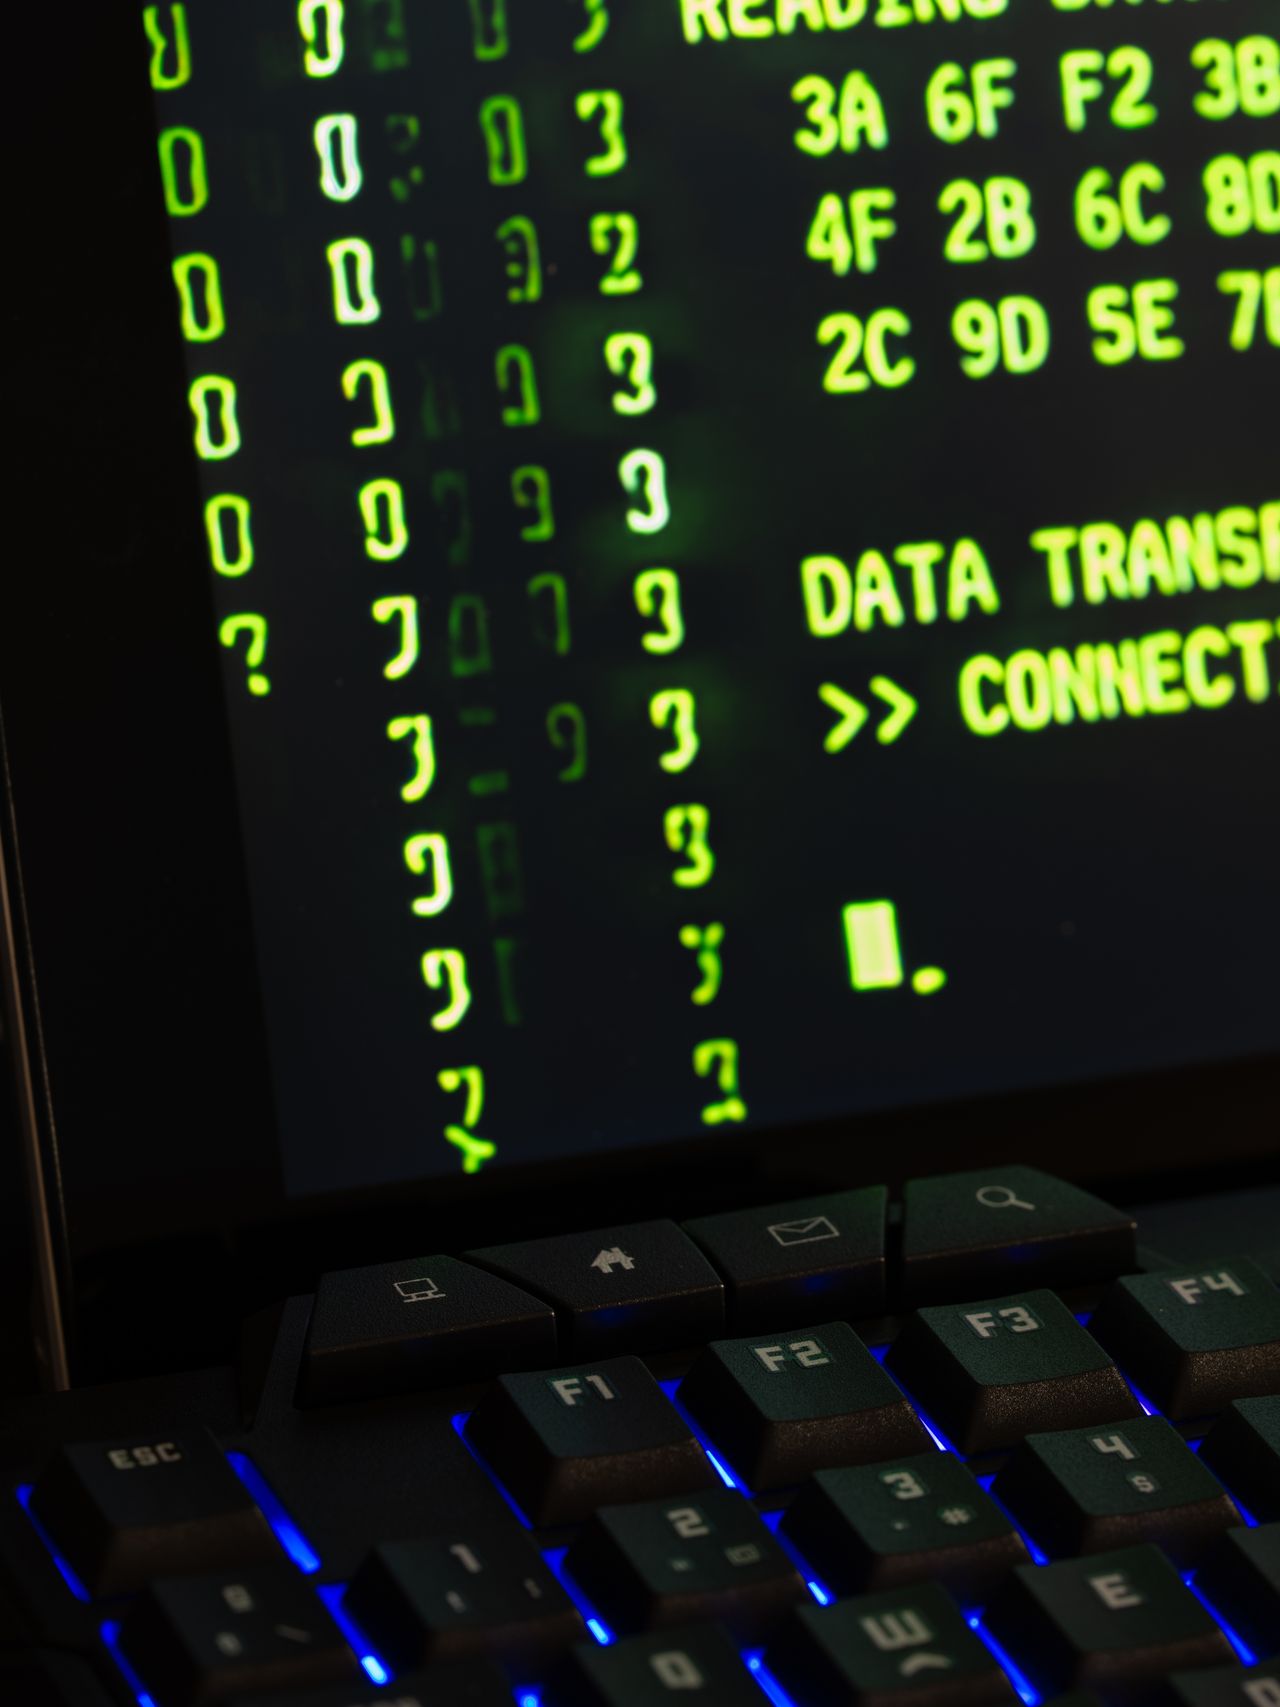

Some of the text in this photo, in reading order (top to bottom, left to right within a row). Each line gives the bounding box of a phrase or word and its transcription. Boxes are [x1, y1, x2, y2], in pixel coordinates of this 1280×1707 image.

[791, 70, 888, 157] 3A
[925, 57, 1016, 144] 6F
[1059, 45, 1157, 132] F2
[806, 188, 896, 276] 4F
[938, 176, 1036, 263] 2B
[1074, 162, 1171, 250] 6C
[817, 307, 915, 394] 2C
[951, 295, 1050, 379] 9D
[801, 539, 1000, 637] DATA
[1169, 1271, 1245, 1305] F4
[964, 1306, 1039, 1338] F3
[753, 1340, 830, 1372] F2
[551, 1374, 614, 1406] F1
[108, 1442, 181, 1470] ESC
[1091, 1435, 1135, 1460] 4
[882, 1471, 925, 1500] 3
[667, 1507, 709, 1538] 2
[1089, 1573, 1141, 1609] E
[860, 1610, 933, 1652] W
